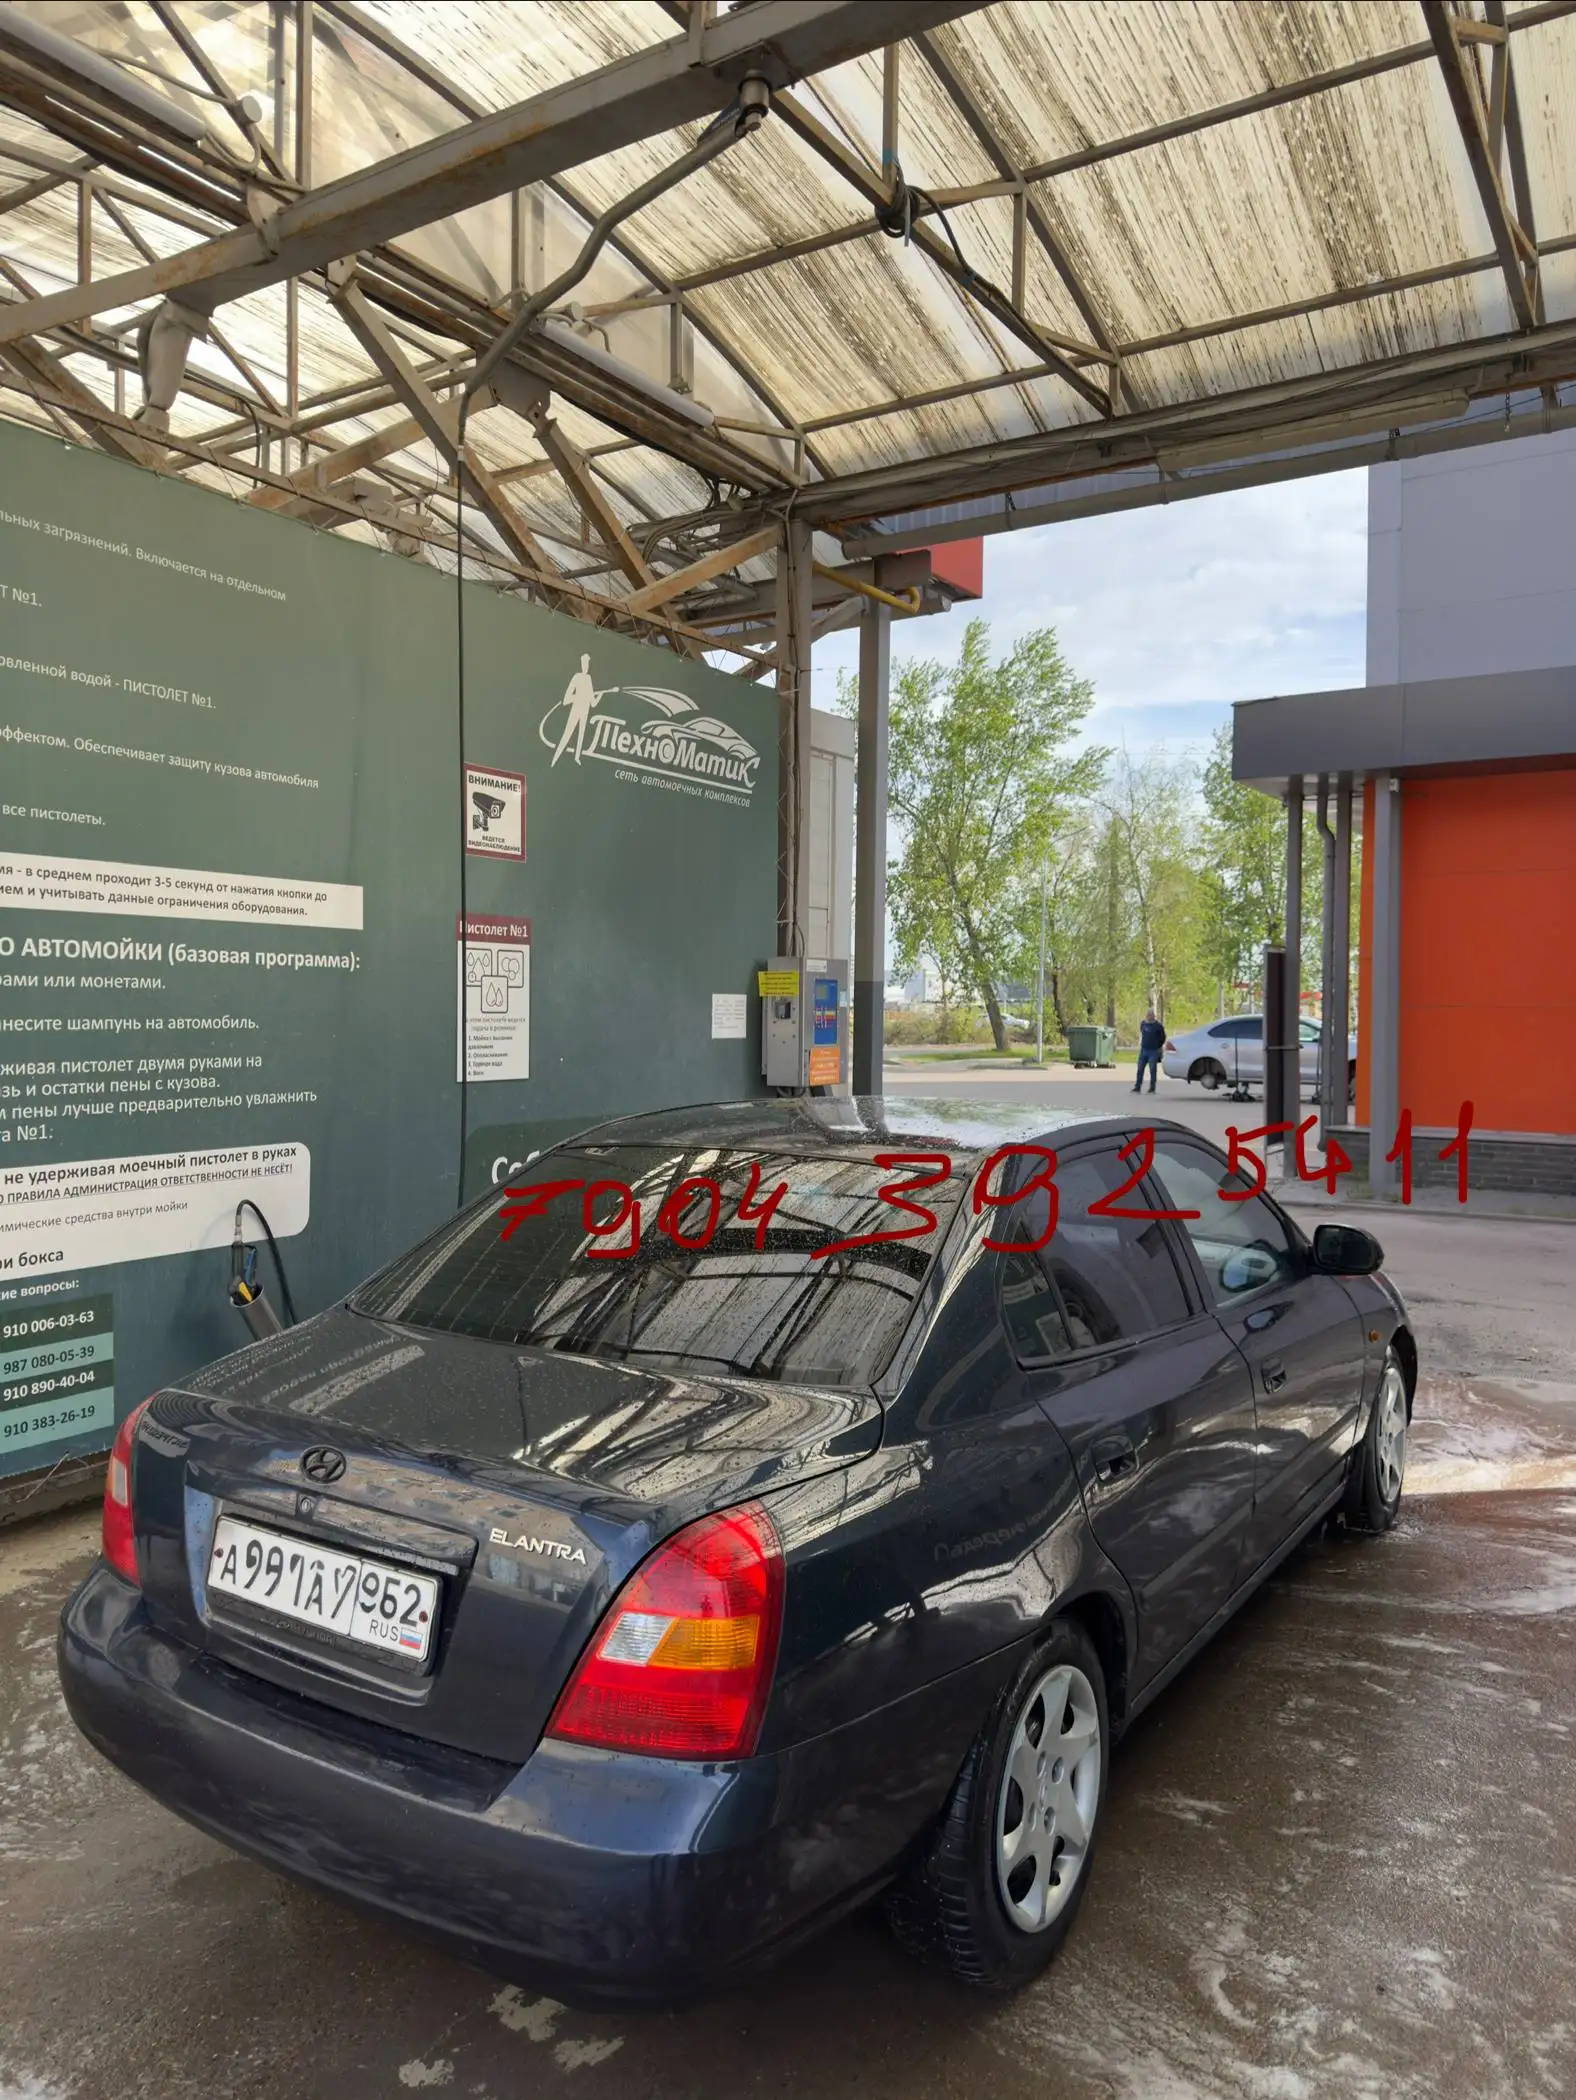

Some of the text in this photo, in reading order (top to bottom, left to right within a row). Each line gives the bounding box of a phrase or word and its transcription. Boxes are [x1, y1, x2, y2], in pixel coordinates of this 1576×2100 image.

[44, 523, 132, 557] загрязнений.
[136, 547, 207, 578] Включается
[210, 572, 223, 583] на
[226, 576, 286, 601] отдельном
[12, 587, 42, 607] №1.
[71, 670, 111, 687] водой
[123, 679, 188, 702] ПИСТОЛЕТ
[191, 693, 216, 709] №1.
[74, 737, 165, 763] Обеспечивает
[168, 753, 211, 774] защиту
[214, 763, 252, 778] кузова
[255, 770, 319, 789] автомобиля
[468, 775, 521, 793] ВНИМАНИЕ!
[614, 769, 750, 807] сеть автомоечных комплексов
[2, 804, 106, 826] все пистолеты.
[25, 868, 33, 877] в
[36, 868, 91, 883] среднем
[95, 873, 151, 887] проходит
[155, 876, 172, 888] 3-5
[175, 878, 213, 893] секунд
[216, 884, 228, 892] от
[231, 885, 274, 897] нажатия
[277, 889, 312, 900] кнопки
[314, 892, 327, 902] до
[28, 887, 35, 896] и
[39, 888, 105, 901] учитывать
[108, 892, 154, 904] данные
[157, 895, 228, 910] ограничения
[231, 901, 308, 916] оборудования.
[510, 924, 528, 937] №1
[21, 937, 162, 961] АВТОМОЙКИ
[168, 943, 250, 966] (базовая
[255, 951, 360, 972] программа):
[44, 976, 75, 987] или
[80, 976, 166, 989] монетами.
[67, 1018, 141, 1033] шампунь
[146, 1018, 163, 1029] на
[168, 1015, 259, 1030] автомобиль.
[61, 1059, 134, 1073] пистолет
[137, 1058, 185, 1074] двумя
[189, 1056, 242, 1072] руками
[246, 1056, 262, 1068] на
[26, 1084, 36, 1096] и
[42, 1081, 105, 1095] остатки
[110, 1079, 150, 1092] пены
[155, 1079, 163, 1090] с
[167, 1076, 220, 1092] кузова.
[12, 1105, 57, 1119] пены
[62, 1102, 114, 1119] лучше
[119, 1094, 242, 1115] предварительно
[245, 1090, 317, 1108] увлажнить
[4, 1147, 296, 1185] не удерживая моечный пистолет в руках
[7, 1188, 60, 1203] ПРАВИЛА
[63, 1178, 158, 1199] АДМИНИСТРАЦИЯ
[161, 1168, 249, 1186] ОТВЕТСТВЕННОСТИ
[251, 1166, 262, 1176] НЕ
[64, 1210, 114, 1225] средства
[117, 1205, 153, 1218] внутри
[155, 1201, 188, 1213] мойки
[18, 1250, 64, 1267] бокса
[20, 1279, 80, 1297] вопросы:
[3, 1310, 94, 1338] 910 006-03-63
[3, 1345, 95, 1375] 987 080-05-39
[3, 1370, 95, 1401] 910 890-40-04
[4, 1405, 95, 1438] 910 383-26-19
[489, 1527, 587, 1566] ELANTRA
[369, 1619, 399, 1642] RUS
